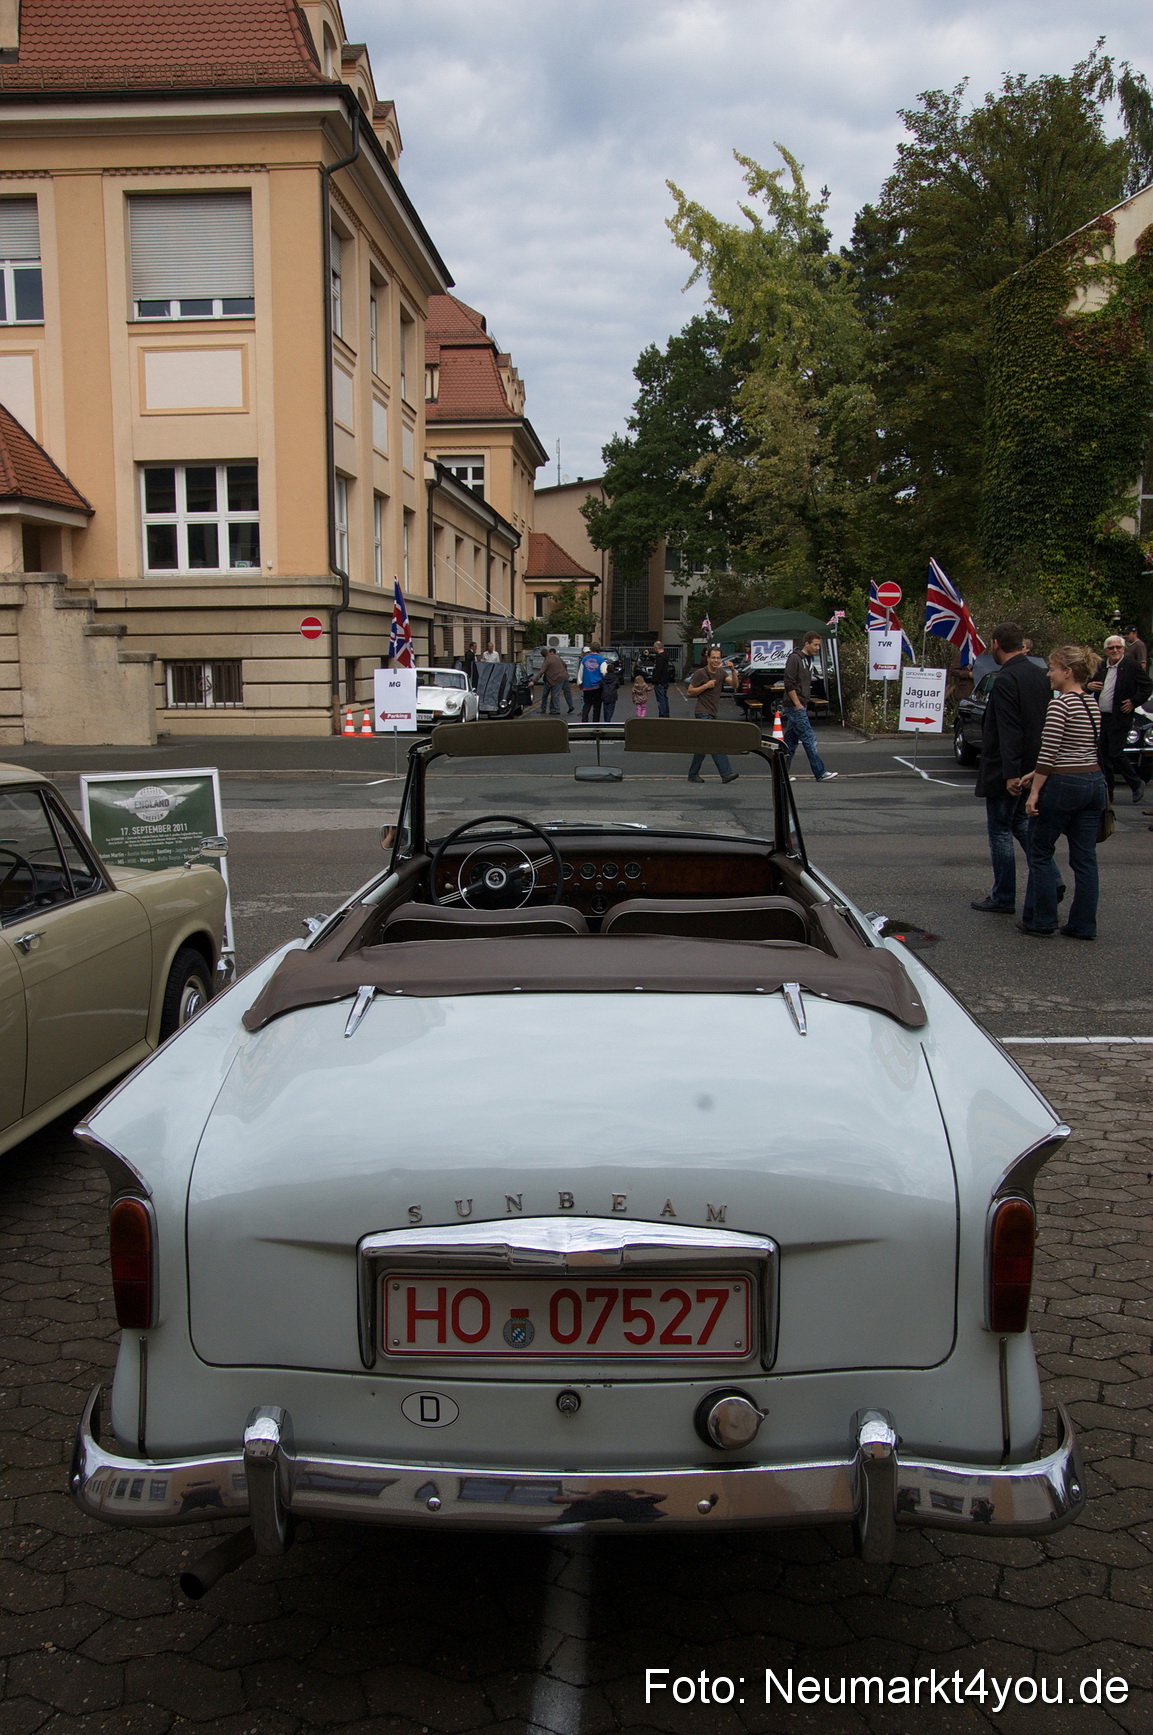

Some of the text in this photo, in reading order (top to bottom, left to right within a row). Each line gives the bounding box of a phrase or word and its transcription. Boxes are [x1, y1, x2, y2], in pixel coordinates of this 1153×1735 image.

[753, 641, 786, 654] TVR
[753, 653, 769, 662] Car
[905, 687, 941, 699] Jaguar
[903, 699, 942, 711] Parking
[134, 798, 170, 809] ENGLAND
[142, 813, 164, 821] TREFFEN
[120, 823, 188, 836] 17. SEPTEMBER 2011
[408, 1191, 728, 1224] SUNBEAM
[420, 1395, 440, 1422] D
